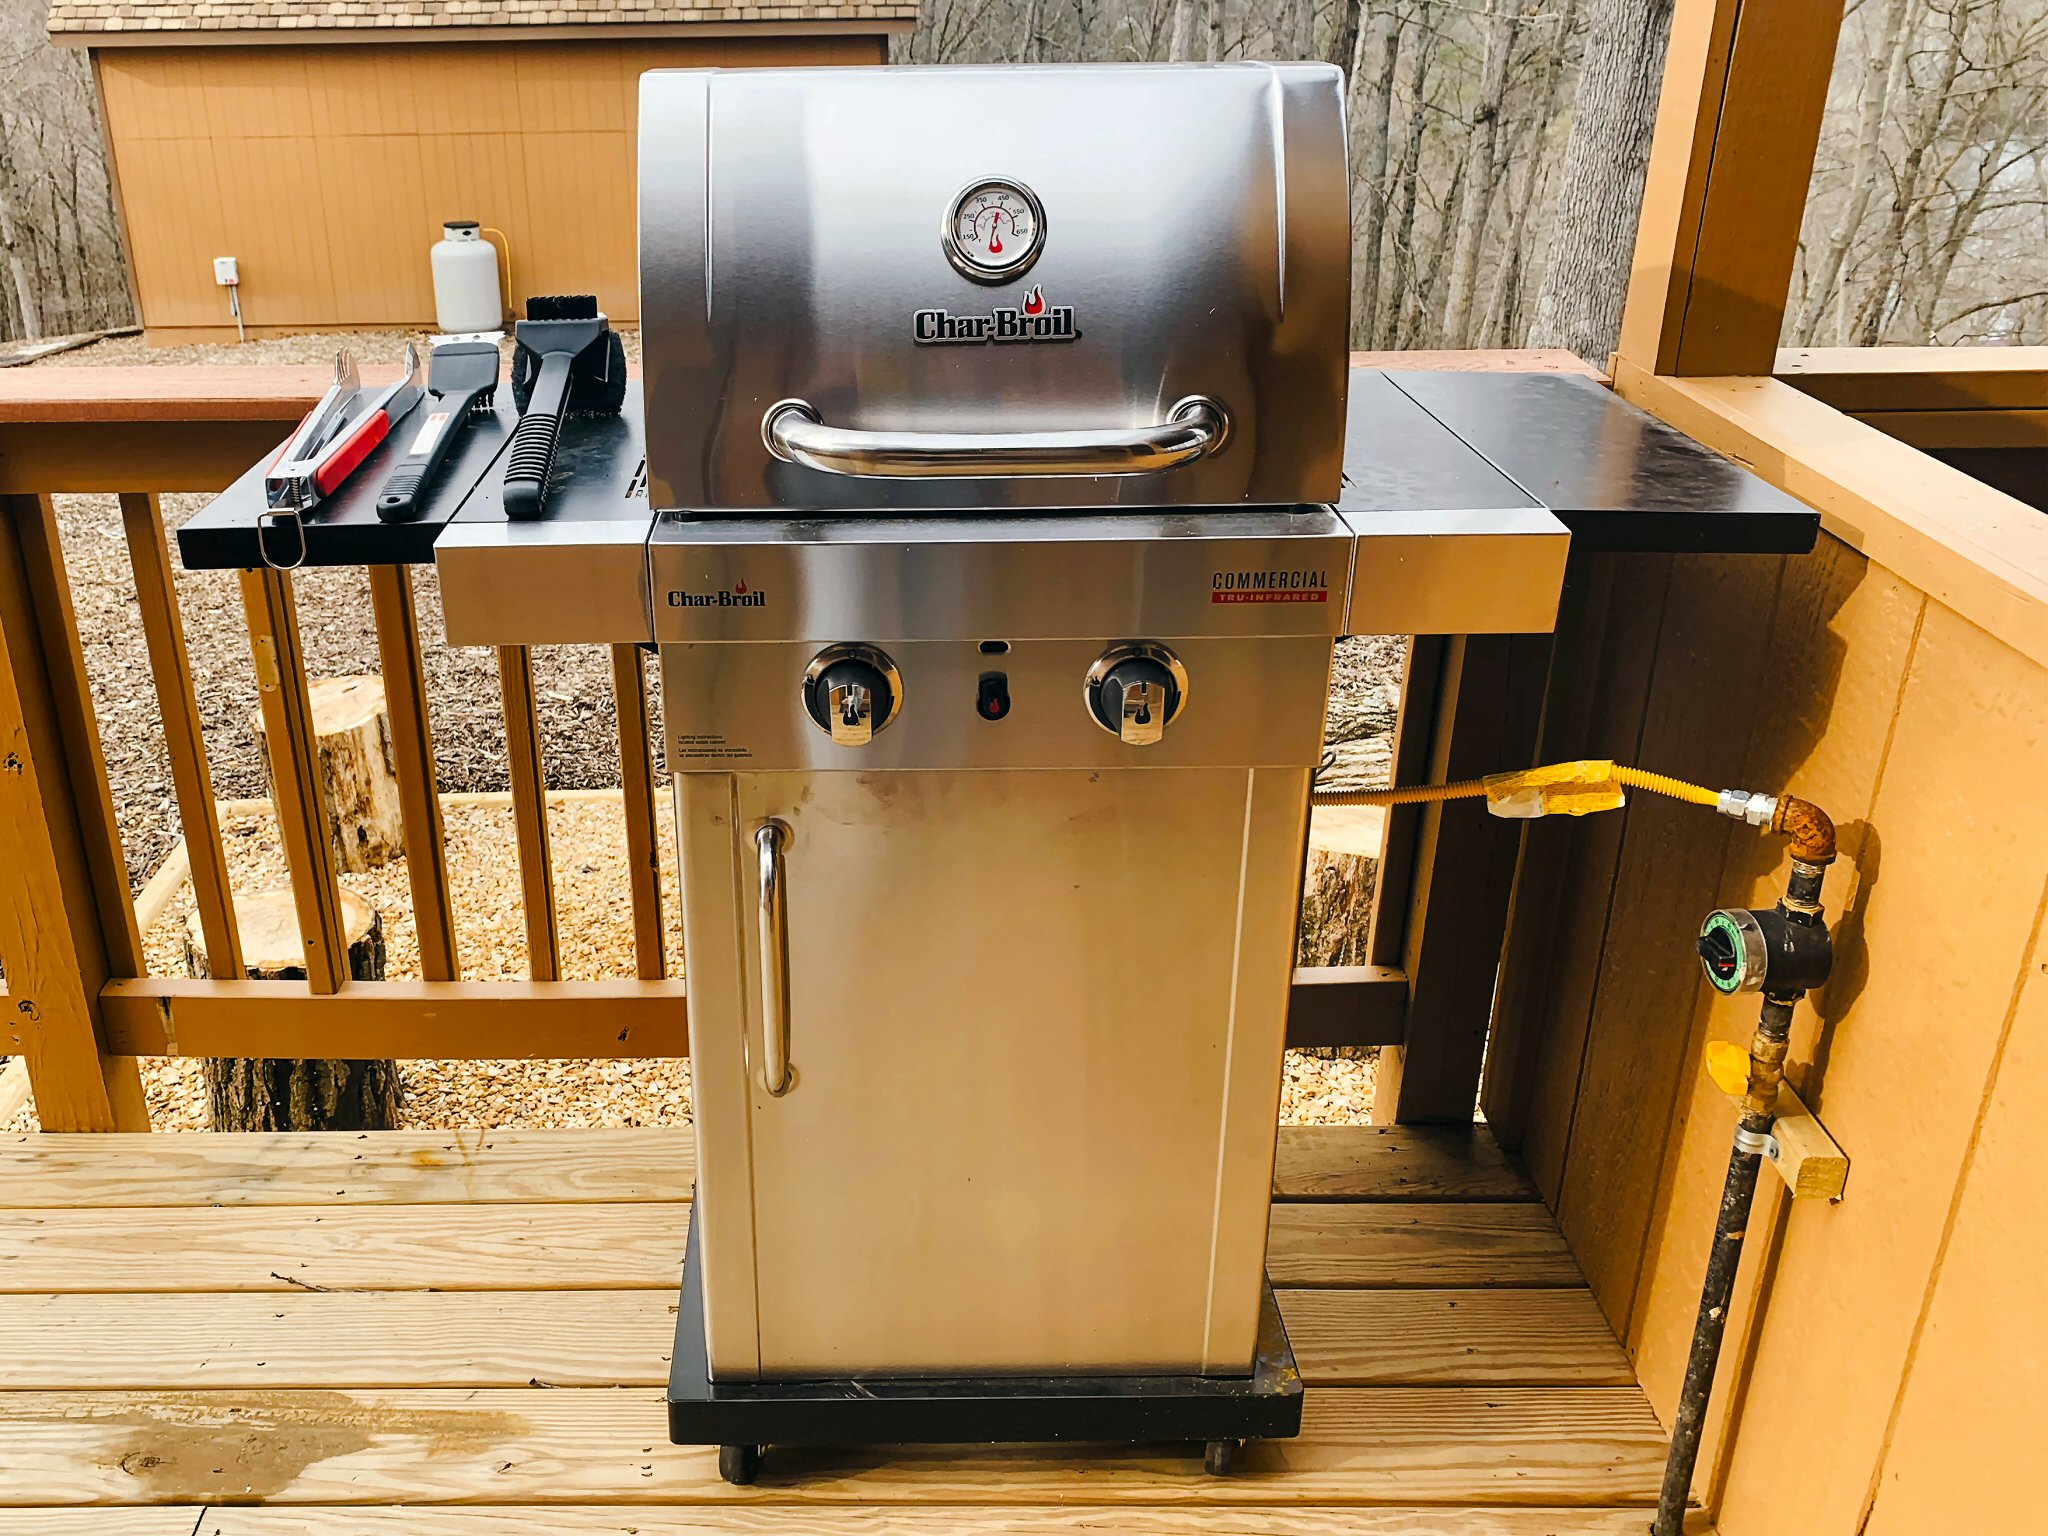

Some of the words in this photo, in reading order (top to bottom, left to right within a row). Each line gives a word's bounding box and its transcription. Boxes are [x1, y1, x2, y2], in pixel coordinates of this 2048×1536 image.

[915, 308, 1073, 341] Char-Broil
[1212, 570, 1328, 590] COMMERCIAL
[667, 590, 765, 607] Char-Broil
[1219, 593, 1319, 601] TRU-INFRARED
